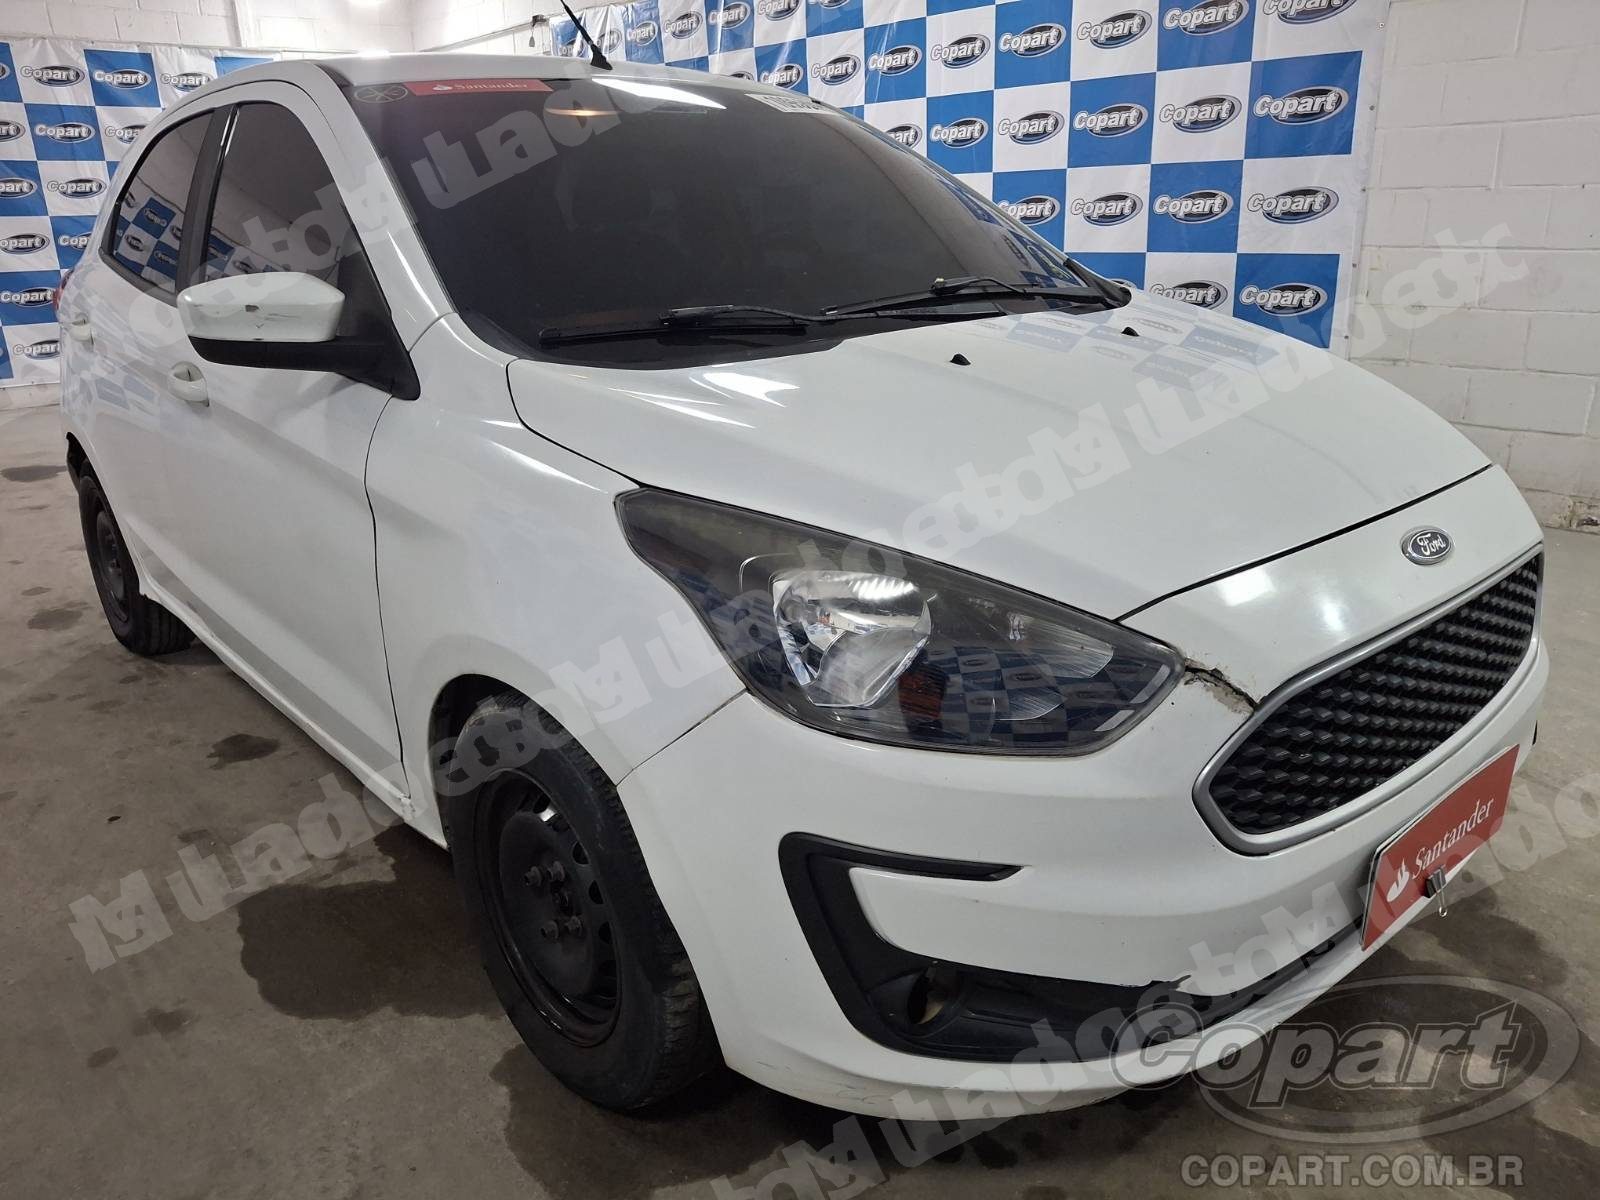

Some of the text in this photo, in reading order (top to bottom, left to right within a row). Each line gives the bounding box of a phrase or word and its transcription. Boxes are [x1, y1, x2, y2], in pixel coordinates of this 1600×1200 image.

[664, 15, 697, 33] Copart
[709, 6, 745, 24] Copart
[1163, 1, 1239, 31] Copart
[1077, 13, 1142, 41] Copart
[931, 39, 982, 63] Copart
[1000, 27, 1057, 53] Copart
[811, 60, 855, 80] Copart
[869, 49, 915, 71] Copart
[21, 66, 76, 82] Copart
[94, 70, 145, 85] Copart
[761, 67, 798, 85] Copart
[1159, 98, 1233, 125] Copart
[1254, 91, 1343, 118] Copart
[999, 114, 1056, 138] Copart
[1073, 107, 1139, 131] Copart
[35, 124, 88, 137] Copart
[930, 122, 981, 144] Copart
[47, 181, 99, 193] Copart
[1071, 198, 1134, 219] Copart
[1153, 193, 1226, 219] Copart
[1247, 190, 1326, 218] Copart
[0, 236, 41, 250] opart
[1, 290, 53, 304] Copart
[1240, 285, 1317, 310] Copart
[1417, 533, 1446, 556] Ford
[1412, 798, 1494, 879] Santander
